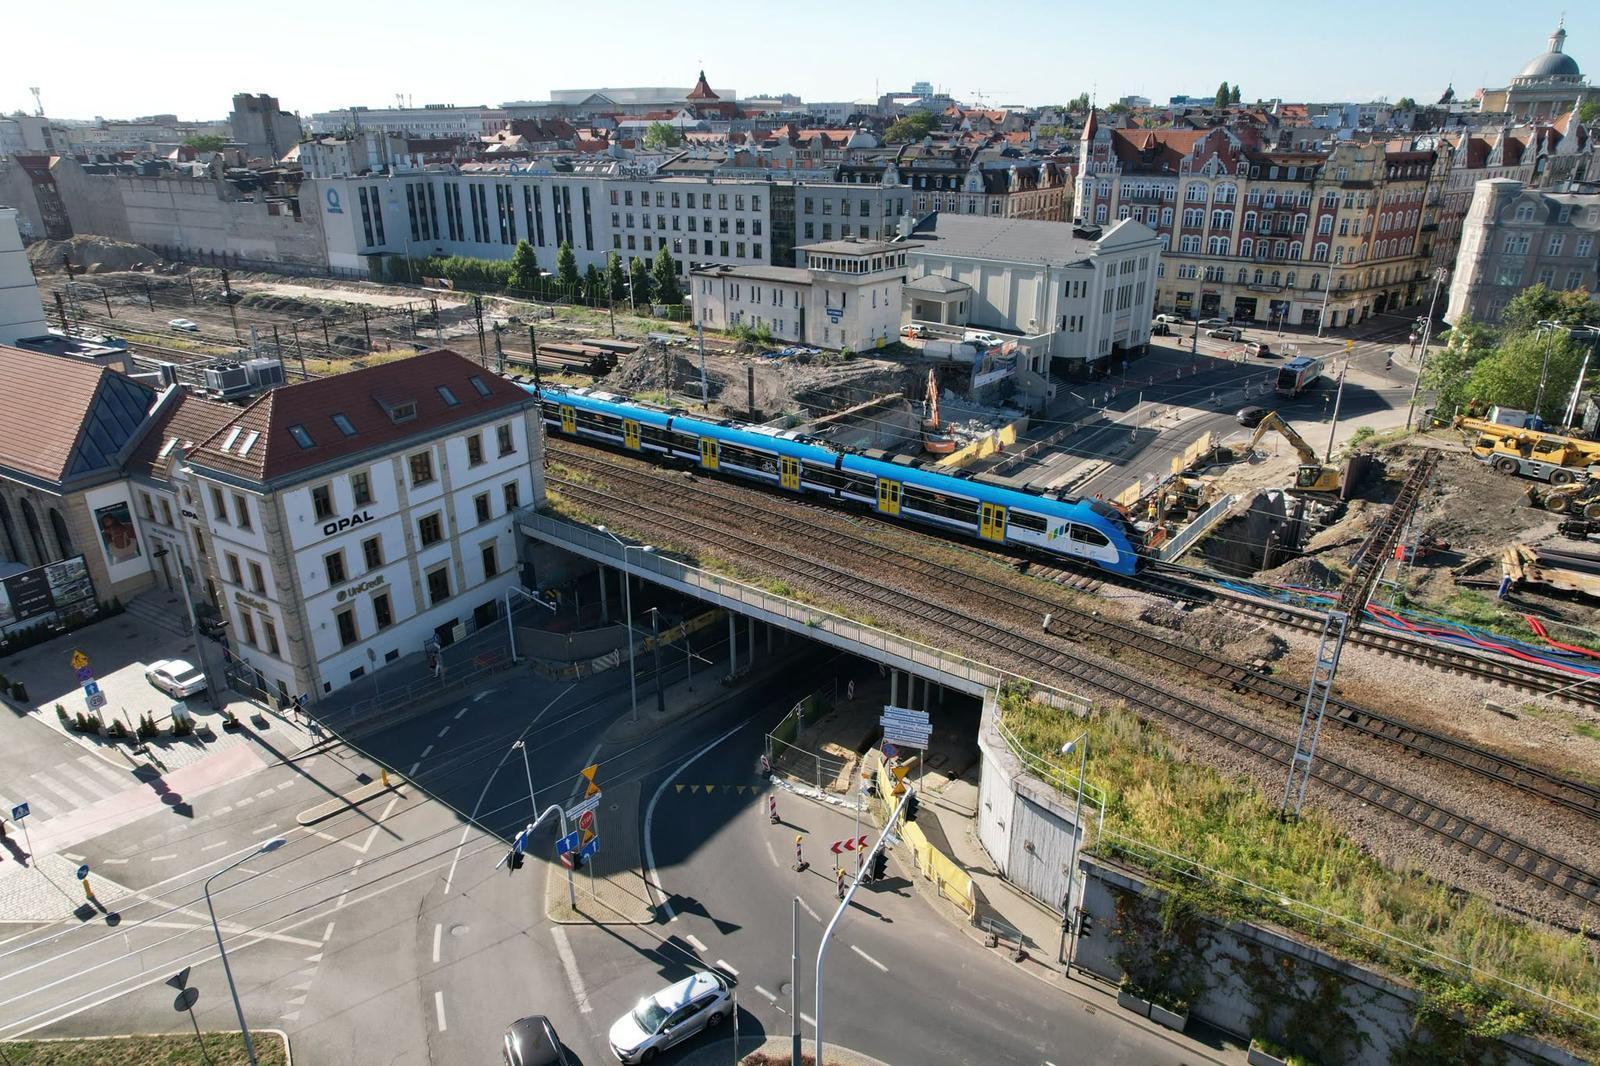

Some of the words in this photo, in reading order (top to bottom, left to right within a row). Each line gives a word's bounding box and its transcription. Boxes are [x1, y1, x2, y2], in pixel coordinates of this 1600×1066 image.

[181, 509, 199, 520] OPA
[323, 511, 374, 536] OPAL
[347, 575, 385, 597] UniCredit
[581, 813, 592, 827] STOP
